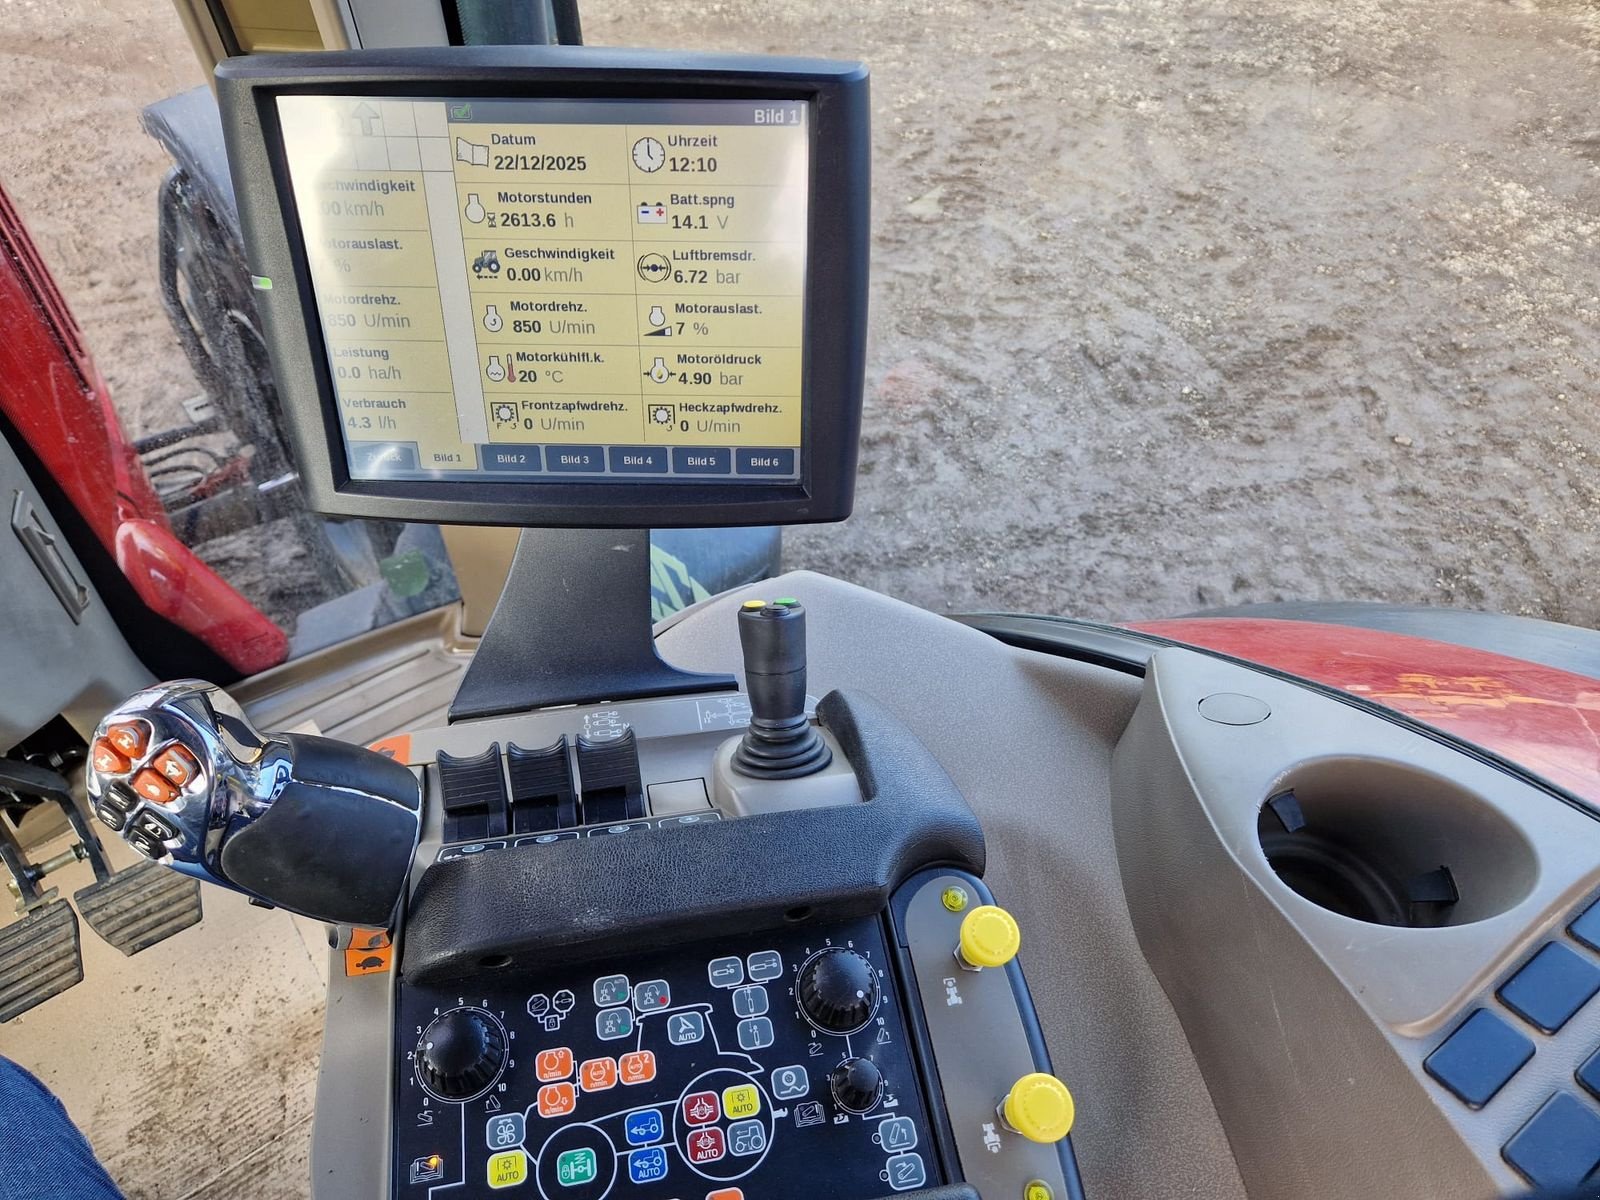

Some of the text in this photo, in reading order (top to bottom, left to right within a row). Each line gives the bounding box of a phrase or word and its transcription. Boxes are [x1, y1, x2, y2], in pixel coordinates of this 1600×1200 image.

[754, 109, 799, 124] Bild 1
[491, 133, 536, 145] Datum
[667, 134, 718, 147] Uhrzeit
[494, 154, 587, 171] 22/12/2025
[669, 157, 718, 172] 12:10
[498, 192, 592, 204] Motorstunden
[670, 194, 735, 208] Batt.spng
[344, 200, 385, 216] km/h
[500, 212, 574, 228] 2613.6 h
[672, 215, 729, 230] 14.1 V
[504, 247, 615, 262] Geschwindigkeit
[672, 250, 756, 262] Luftbremsdr.
[507, 267, 583, 282] 0.00 km/h
[674, 270, 741, 284] 6.72 bar
[323, 294, 401, 305] Motordrehz.
[510, 301, 588, 312] Motordrehz.
[675, 303, 762, 314] Motorauslast.
[328, 313, 411, 328] 850 U/min
[513, 320, 596, 334] 850 U/min
[676, 322, 709, 336] 7 %
[333, 348, 390, 360] Leistung
[516, 352, 604, 364] Motorkühlfl.k.
[677, 354, 762, 365] Motoröldruck
[338, 366, 402, 380] 0.0 ha/h
[518, 370, 564, 383] 20 °C
[678, 372, 744, 386] 4.90 bar
[343, 398, 406, 409] Verbrauch
[522, 400, 628, 414] Frontzapfwdrehz.
[680, 402, 782, 415] Heckzapfwdrehz.
[348, 416, 397, 430] 4.3 l/h
[524, 417, 585, 431] 0 U/min
[680, 419, 741, 432] 0 U/min
[434, 454, 455, 462] Bild
[497, 454, 526, 463] Bild 2
[560, 455, 590, 464] Bild 3
[624, 456, 652, 465] Bild 4
[688, 456, 716, 466] Bild 5
[750, 458, 779, 467] Bild 6
[788, 987, 794, 996] 2
[458, 996, 464, 1006] 5
[482, 999, 488, 1008] 6
[882, 995, 888, 1004] 9
[433, 1007, 439, 1016] 4
[500, 1010, 505, 1020] 7
[795, 1011, 800, 1020] 1
[876, 1016, 885, 1026] 10
[416, 1026, 422, 1035] 3
[510, 1031, 516, 1040] 8
[678, 1031, 697, 1042] AUTO
[810, 1029, 816, 1038] 0
[509, 1059, 515, 1068] 9
[604, 1060, 610, 1070] 1
[543, 1070, 562, 1079] n/min
[498, 1082, 507, 1092] 10
[423, 1097, 429, 1106] 0
[732, 1103, 754, 1114] AUTO
[696, 1148, 719, 1160] AUTO
[496, 1170, 519, 1182] AUTO
[638, 1168, 661, 1180] AUTO
